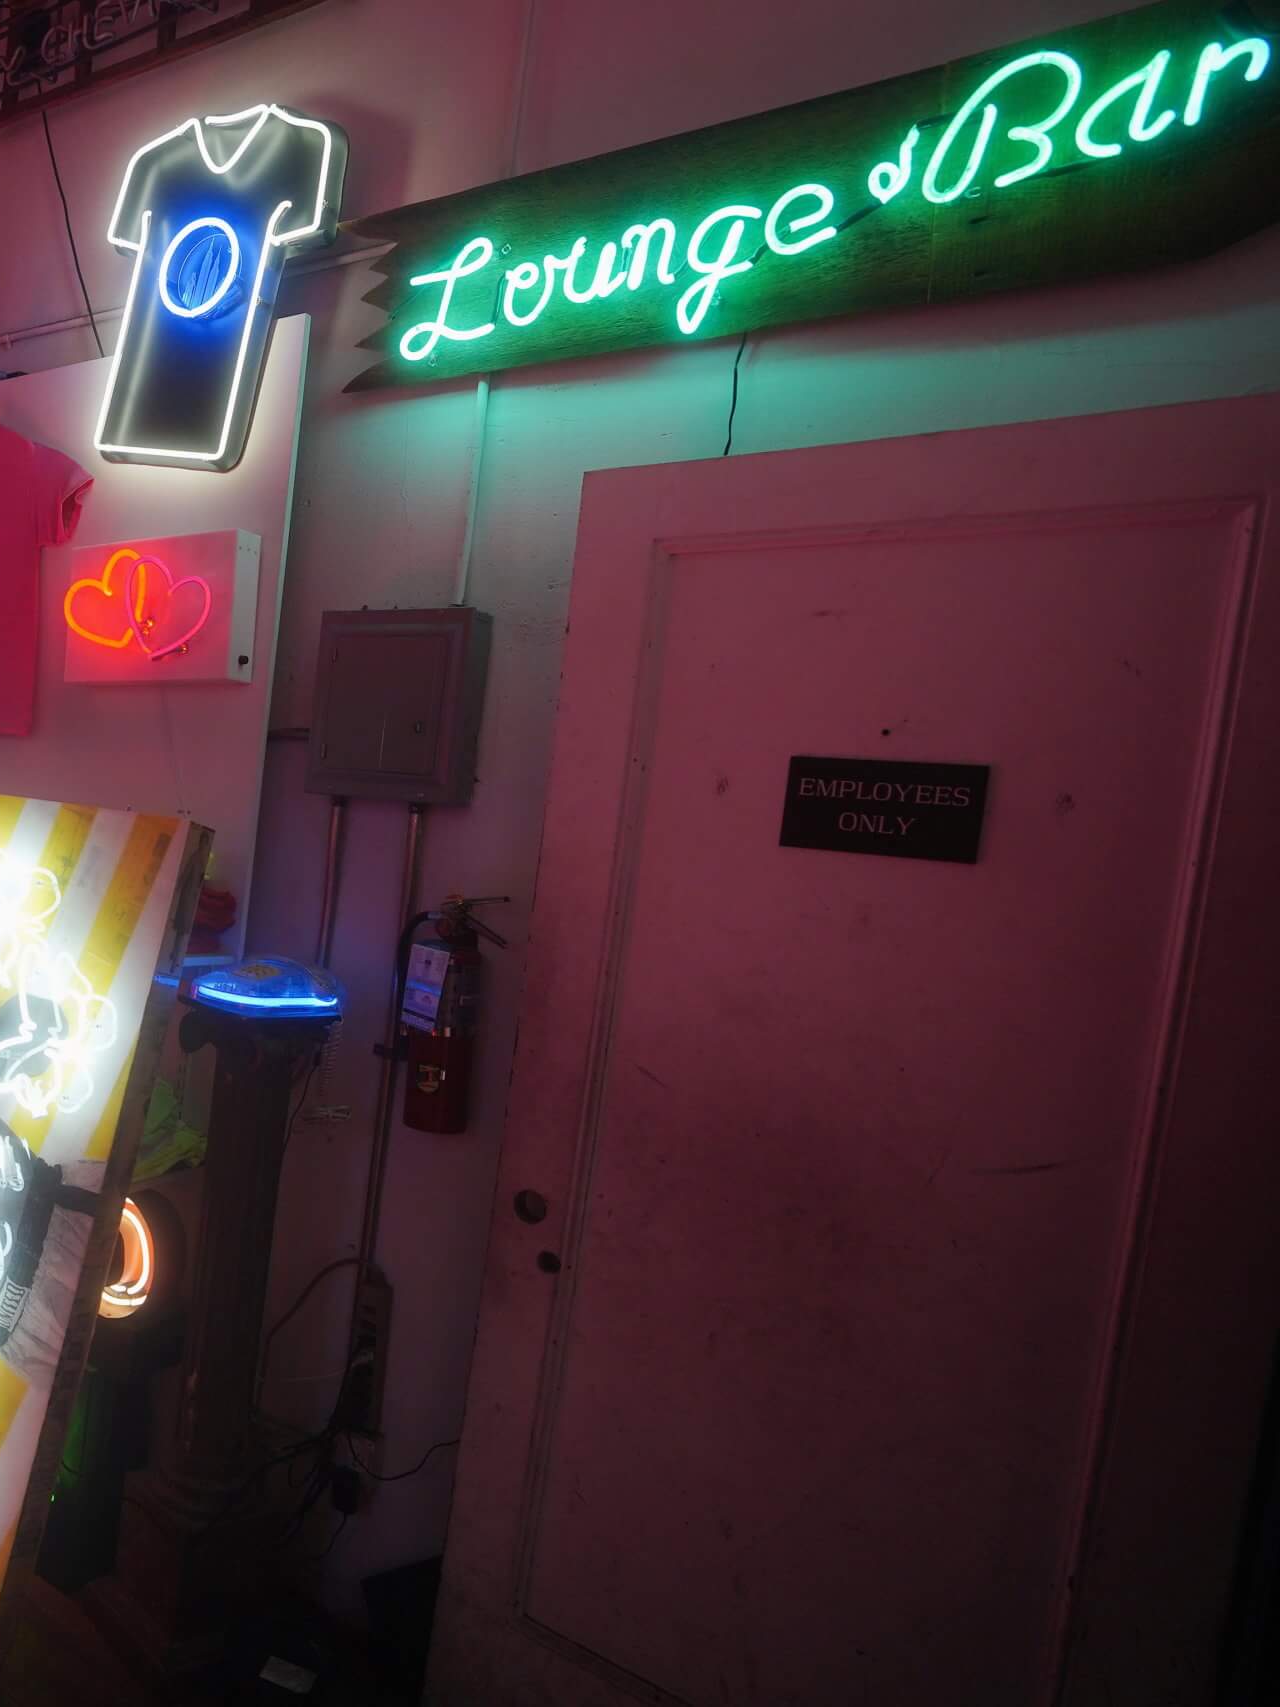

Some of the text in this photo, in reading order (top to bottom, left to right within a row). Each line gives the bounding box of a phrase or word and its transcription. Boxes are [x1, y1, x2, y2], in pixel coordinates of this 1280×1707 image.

[399, 182, 838, 363] Lounge
[922, 37, 1271, 204] Bar
[799, 777, 970, 807] EMPLOYEES
[838, 811, 915, 836] ONLY
